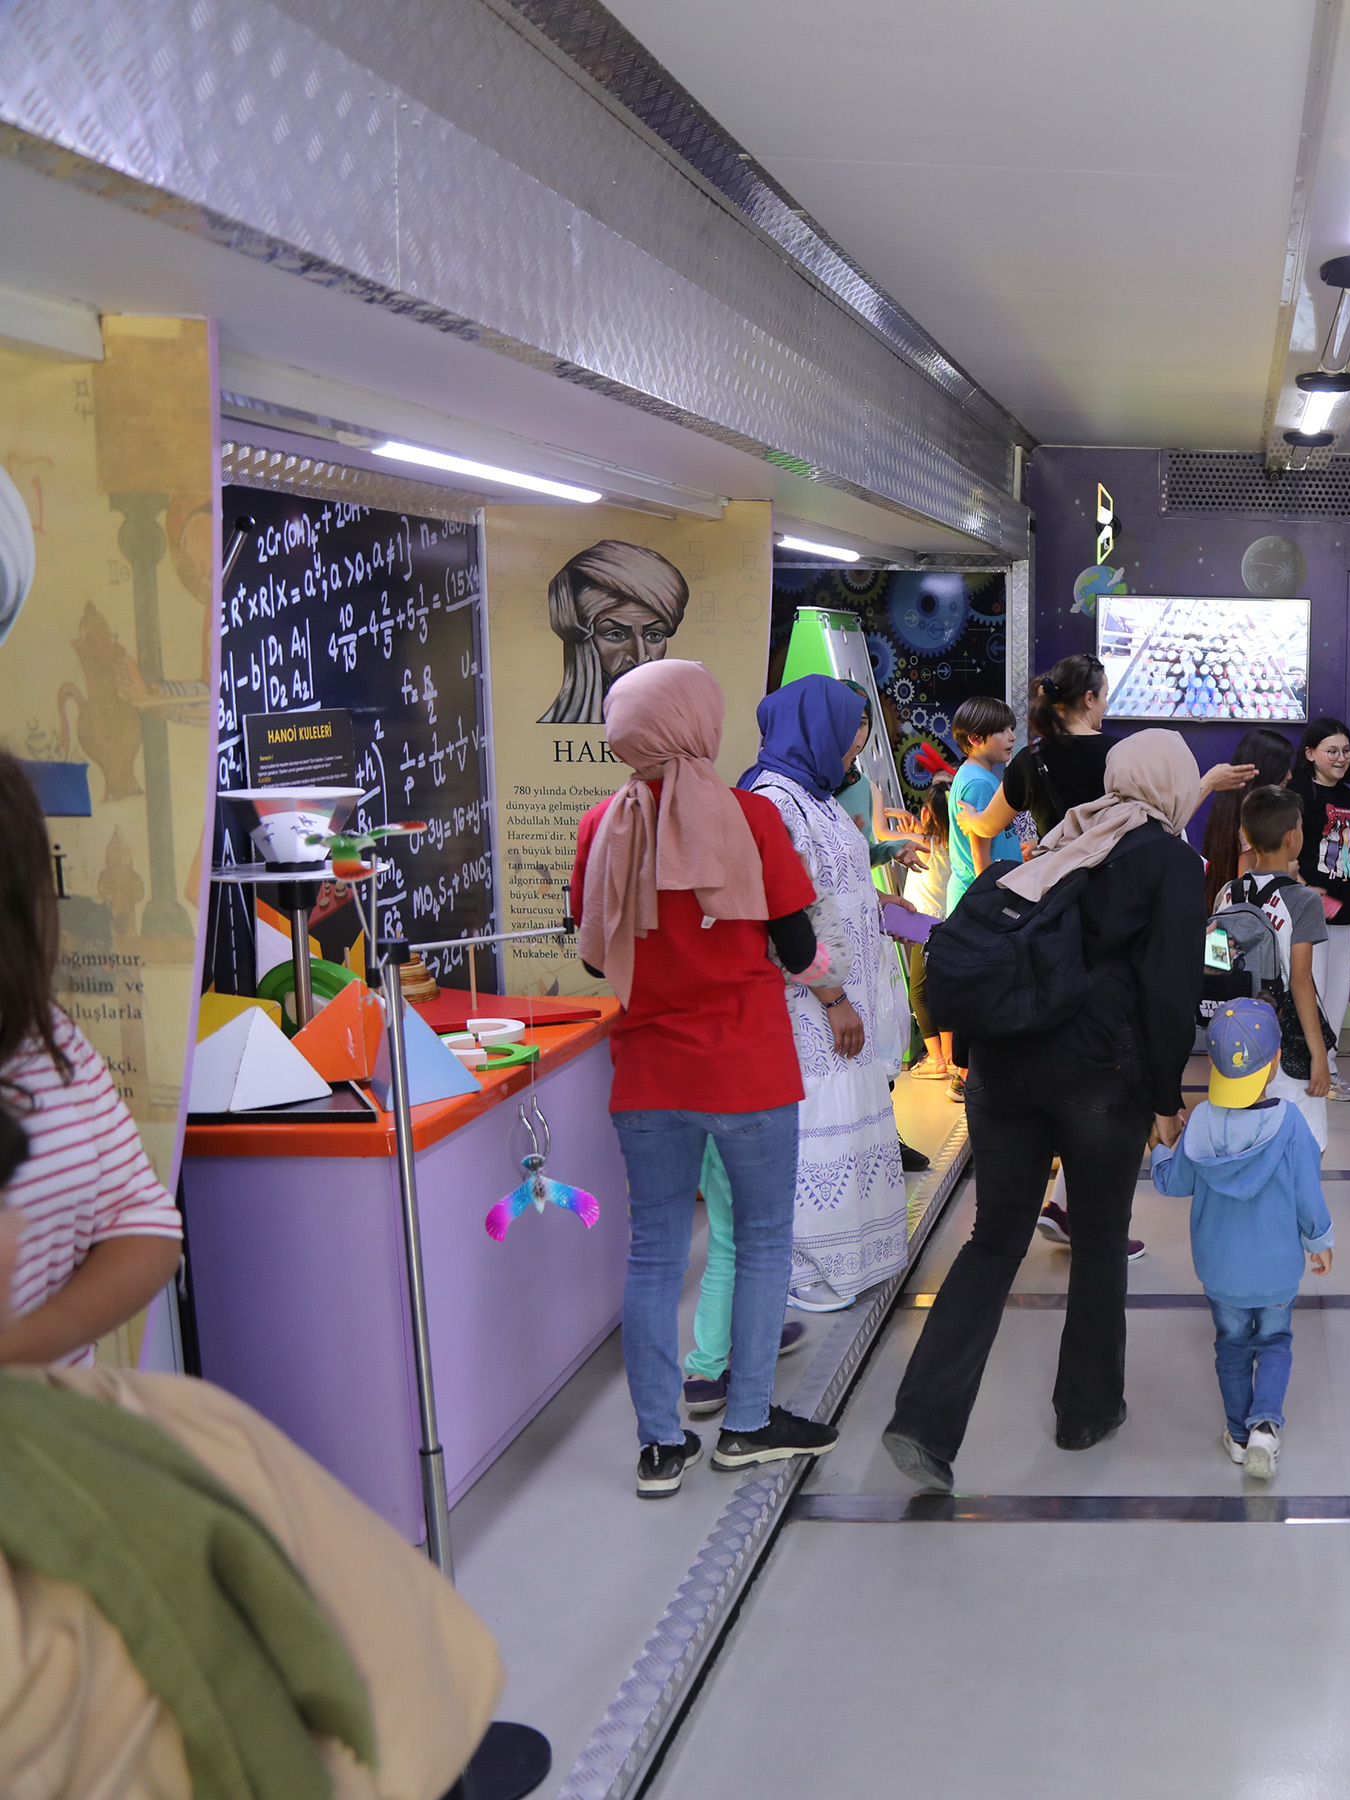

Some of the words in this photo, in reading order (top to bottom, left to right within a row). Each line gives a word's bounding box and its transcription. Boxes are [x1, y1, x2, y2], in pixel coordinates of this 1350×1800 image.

[553, 740, 624, 763] HAR
[513, 785, 531, 796] 780
[534, 786, 567, 798] yılında
[506, 800, 546, 812] dünyaya
[507, 816, 550, 825] Abdullah
[553, 817, 580, 825] Muha
[522, 846, 552, 857] büyük
[509, 875, 570, 887] algoritmanın
[510, 890, 539, 902] büyük
[510, 905, 553, 914] kurucusu
[511, 920, 544, 931] yazılan
[552, 936, 577, 944] Muht
[512, 949, 559, 959] Mukabele
[125, 981, 144, 994] ve
[73, 1003, 143, 1022] luşlarla
